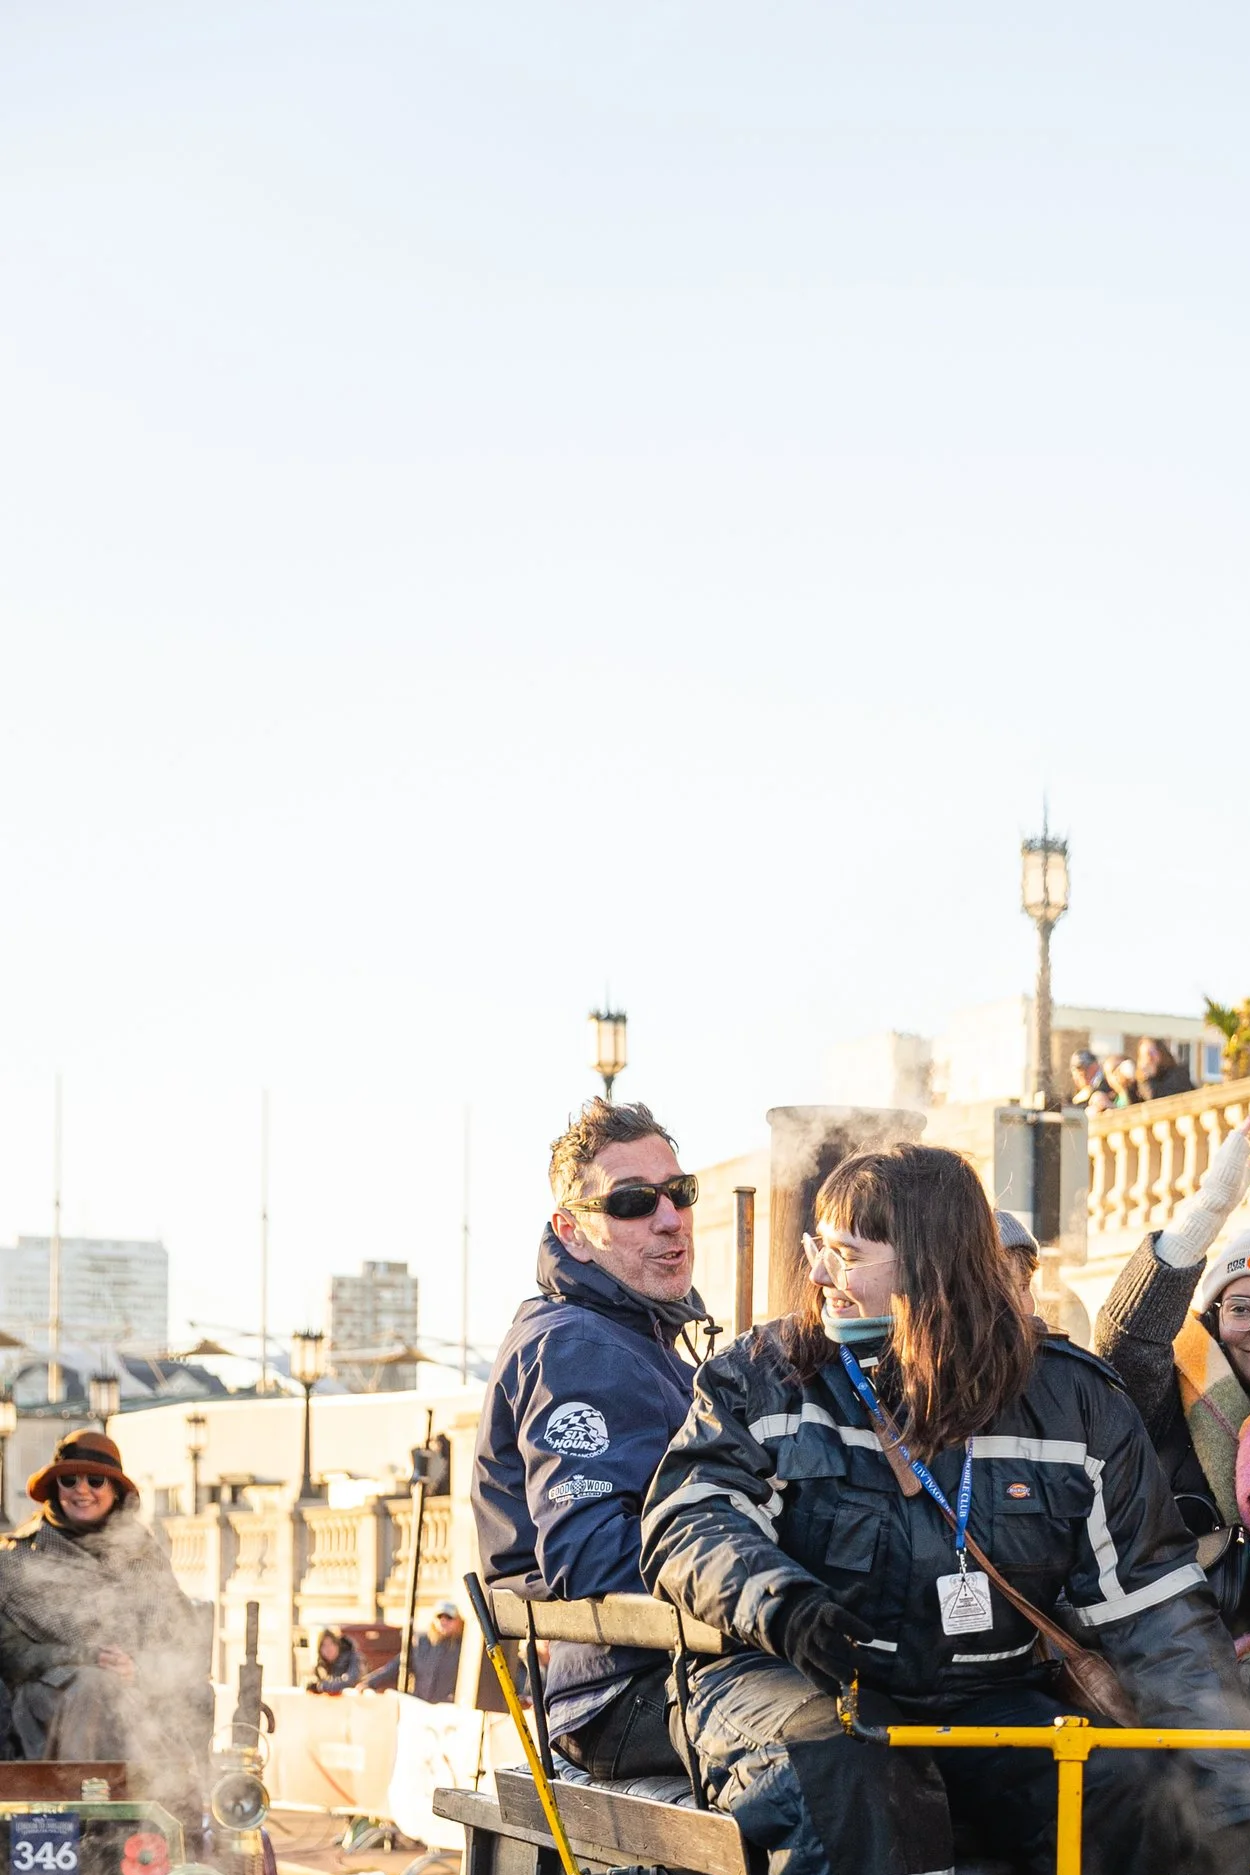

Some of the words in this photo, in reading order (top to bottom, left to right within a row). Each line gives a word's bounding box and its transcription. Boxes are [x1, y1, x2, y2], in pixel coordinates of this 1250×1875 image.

[552, 1439, 599, 1451] HOURS
[562, 1430, 587, 1441] SIX
[925, 1476, 947, 1504] ROYAL
[959, 1492, 969, 1518] CLUB
[13, 1840, 78, 1871] 346
